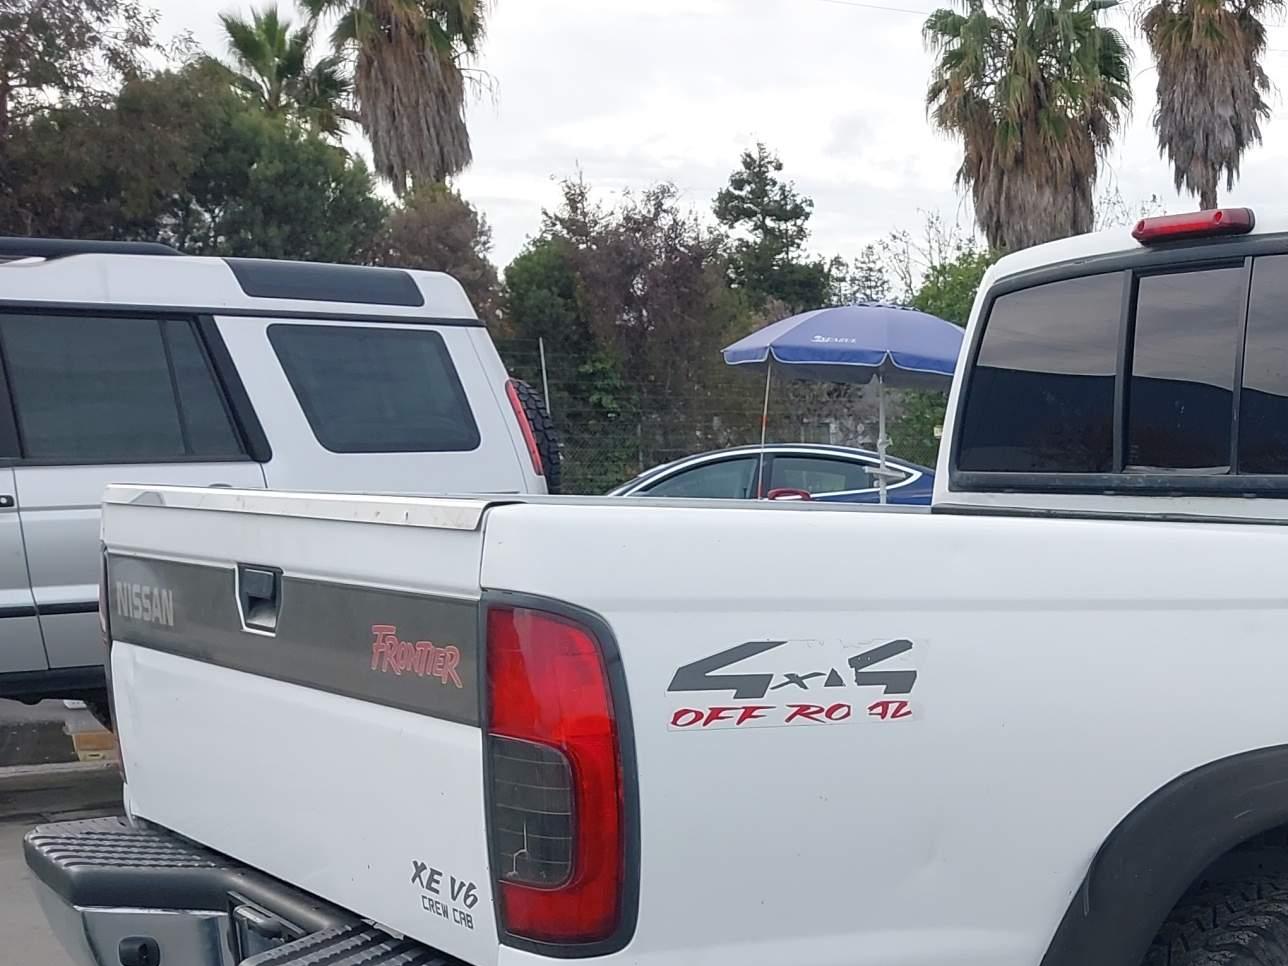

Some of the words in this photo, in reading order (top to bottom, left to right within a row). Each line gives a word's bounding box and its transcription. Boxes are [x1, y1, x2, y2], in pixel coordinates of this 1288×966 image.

[116, 581, 174, 627] NISSAN
[370, 624, 463, 689] FRONTIER
[670, 706, 776, 727] OFF
[411, 860, 443, 895] XE
[450, 875, 479, 909] V6
[421, 894, 449, 919] CREW
[452, 907, 474, 930] CAB
